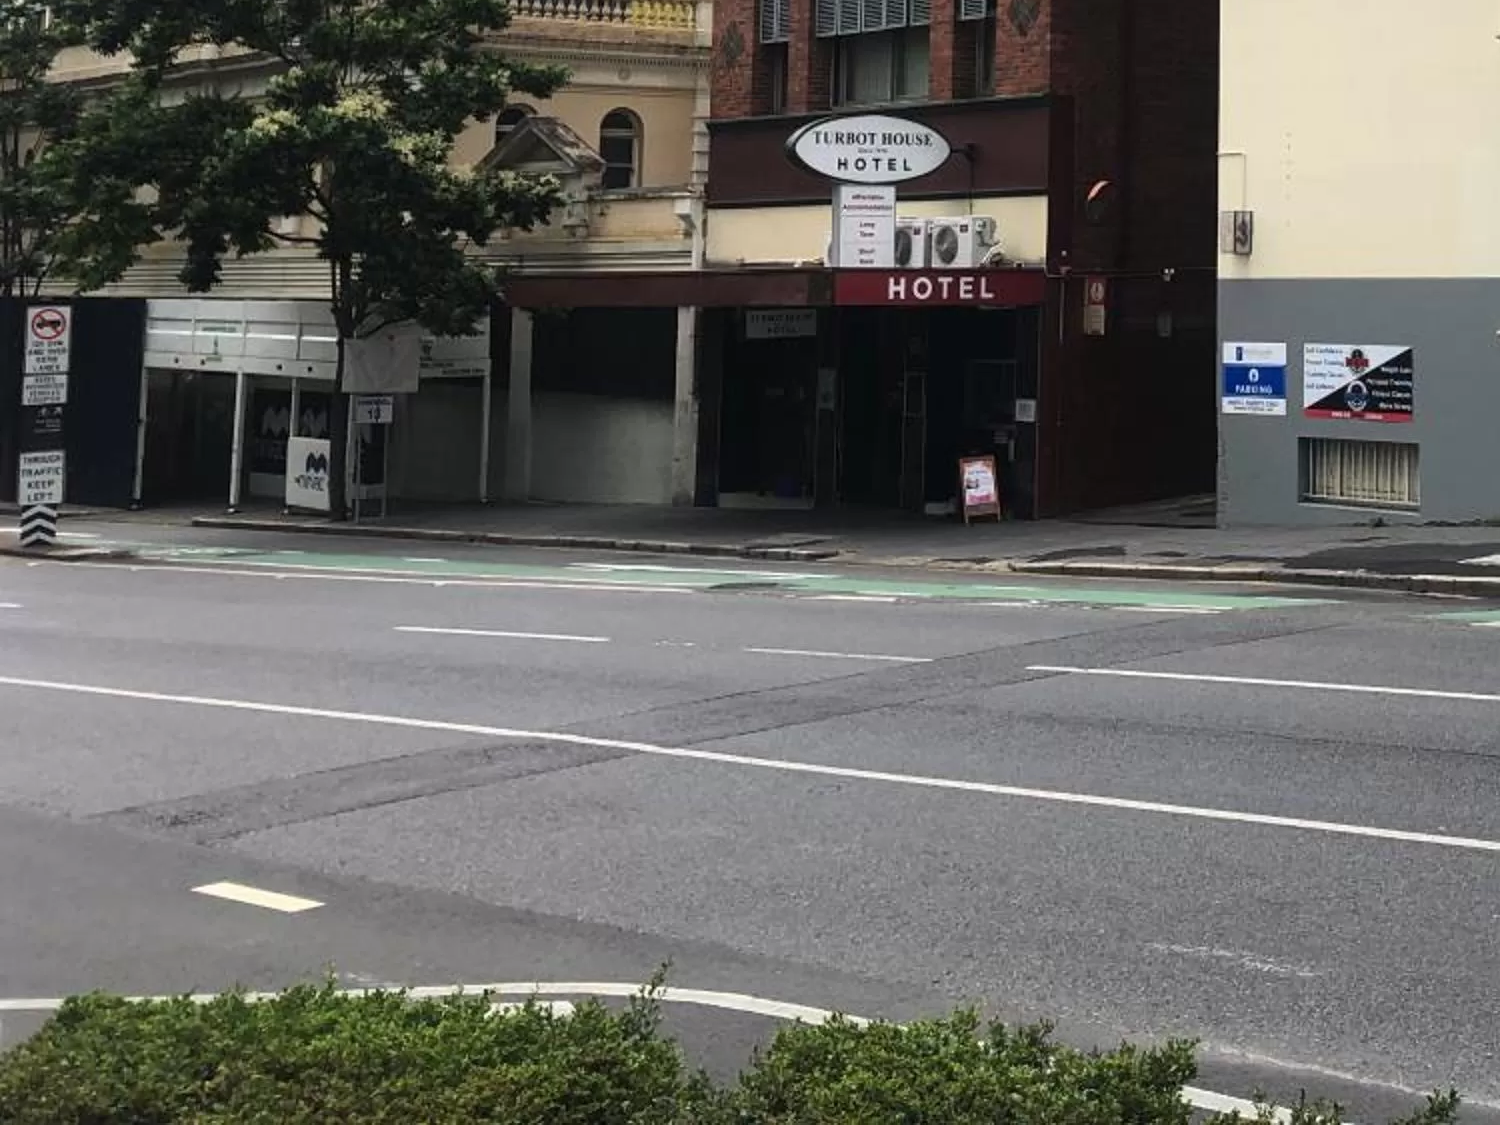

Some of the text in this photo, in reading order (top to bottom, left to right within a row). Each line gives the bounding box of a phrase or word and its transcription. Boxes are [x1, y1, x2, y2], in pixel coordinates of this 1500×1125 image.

[813, 131, 933, 148] TURBOT HOUSE
[837, 157, 913, 172] HOTEL
[887, 276, 995, 300] HOTEL
[1235, 385, 1273, 394] PARKING
[21, 466, 63, 477] TRAFFIC
[27, 479, 56, 489] KEEP
[27, 492, 54, 503] LEFT
